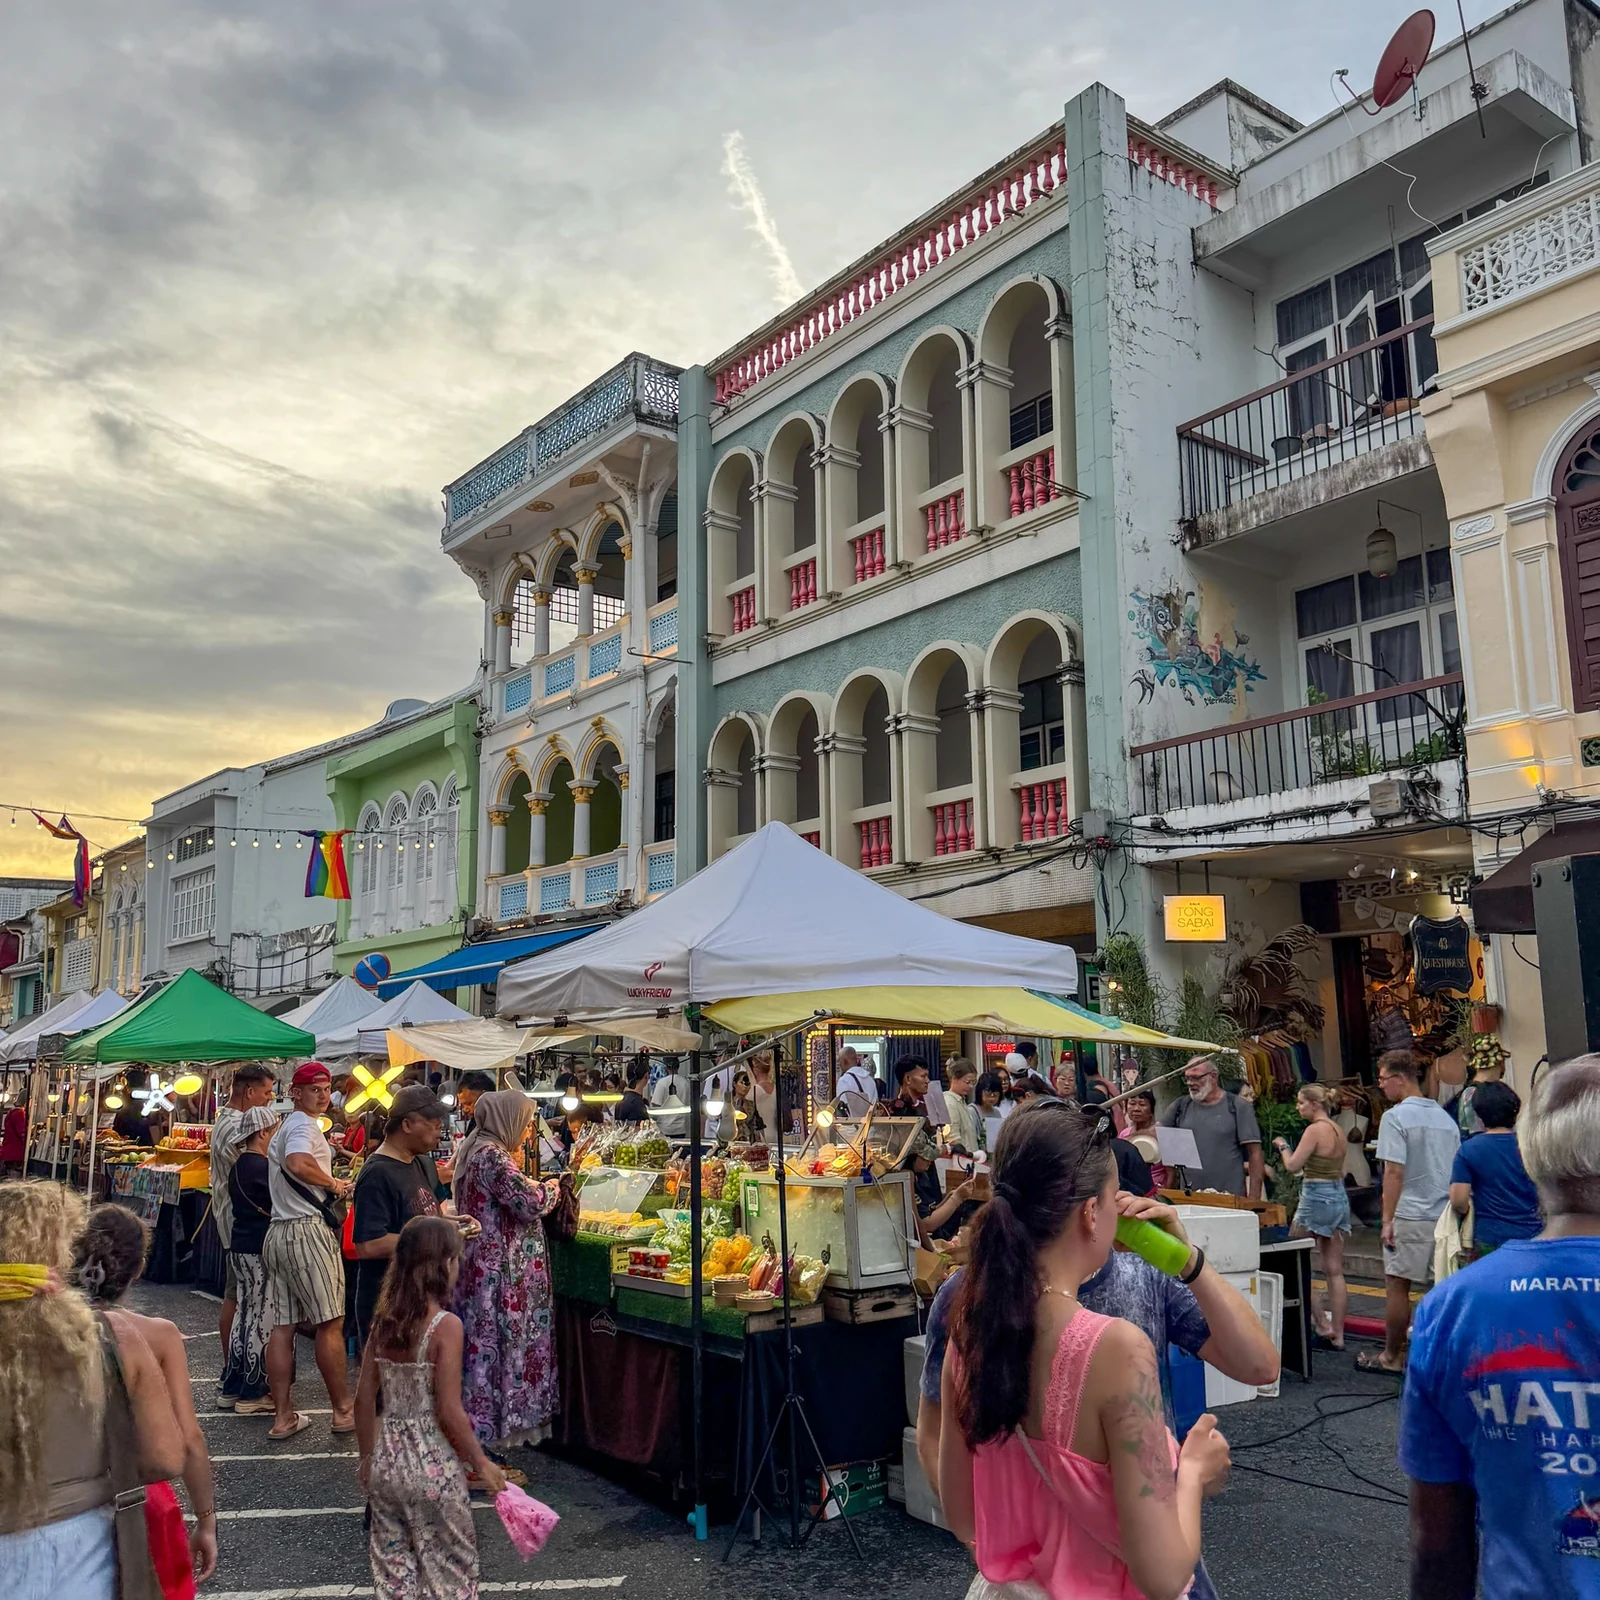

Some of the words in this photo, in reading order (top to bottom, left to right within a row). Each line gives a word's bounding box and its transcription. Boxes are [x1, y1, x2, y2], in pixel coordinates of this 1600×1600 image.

[1176, 906, 1214, 917] TONG
[1177, 917, 1215, 928] SABAI
[1438, 937, 1449, 950] 43
[1422, 957, 1467, 969] GUESTHOUSE
[626, 987, 673, 998] LUCKYFRIEND
[985, 1043, 1016, 1053] WELCOME
[1540, 1451, 1598, 1475] 20
